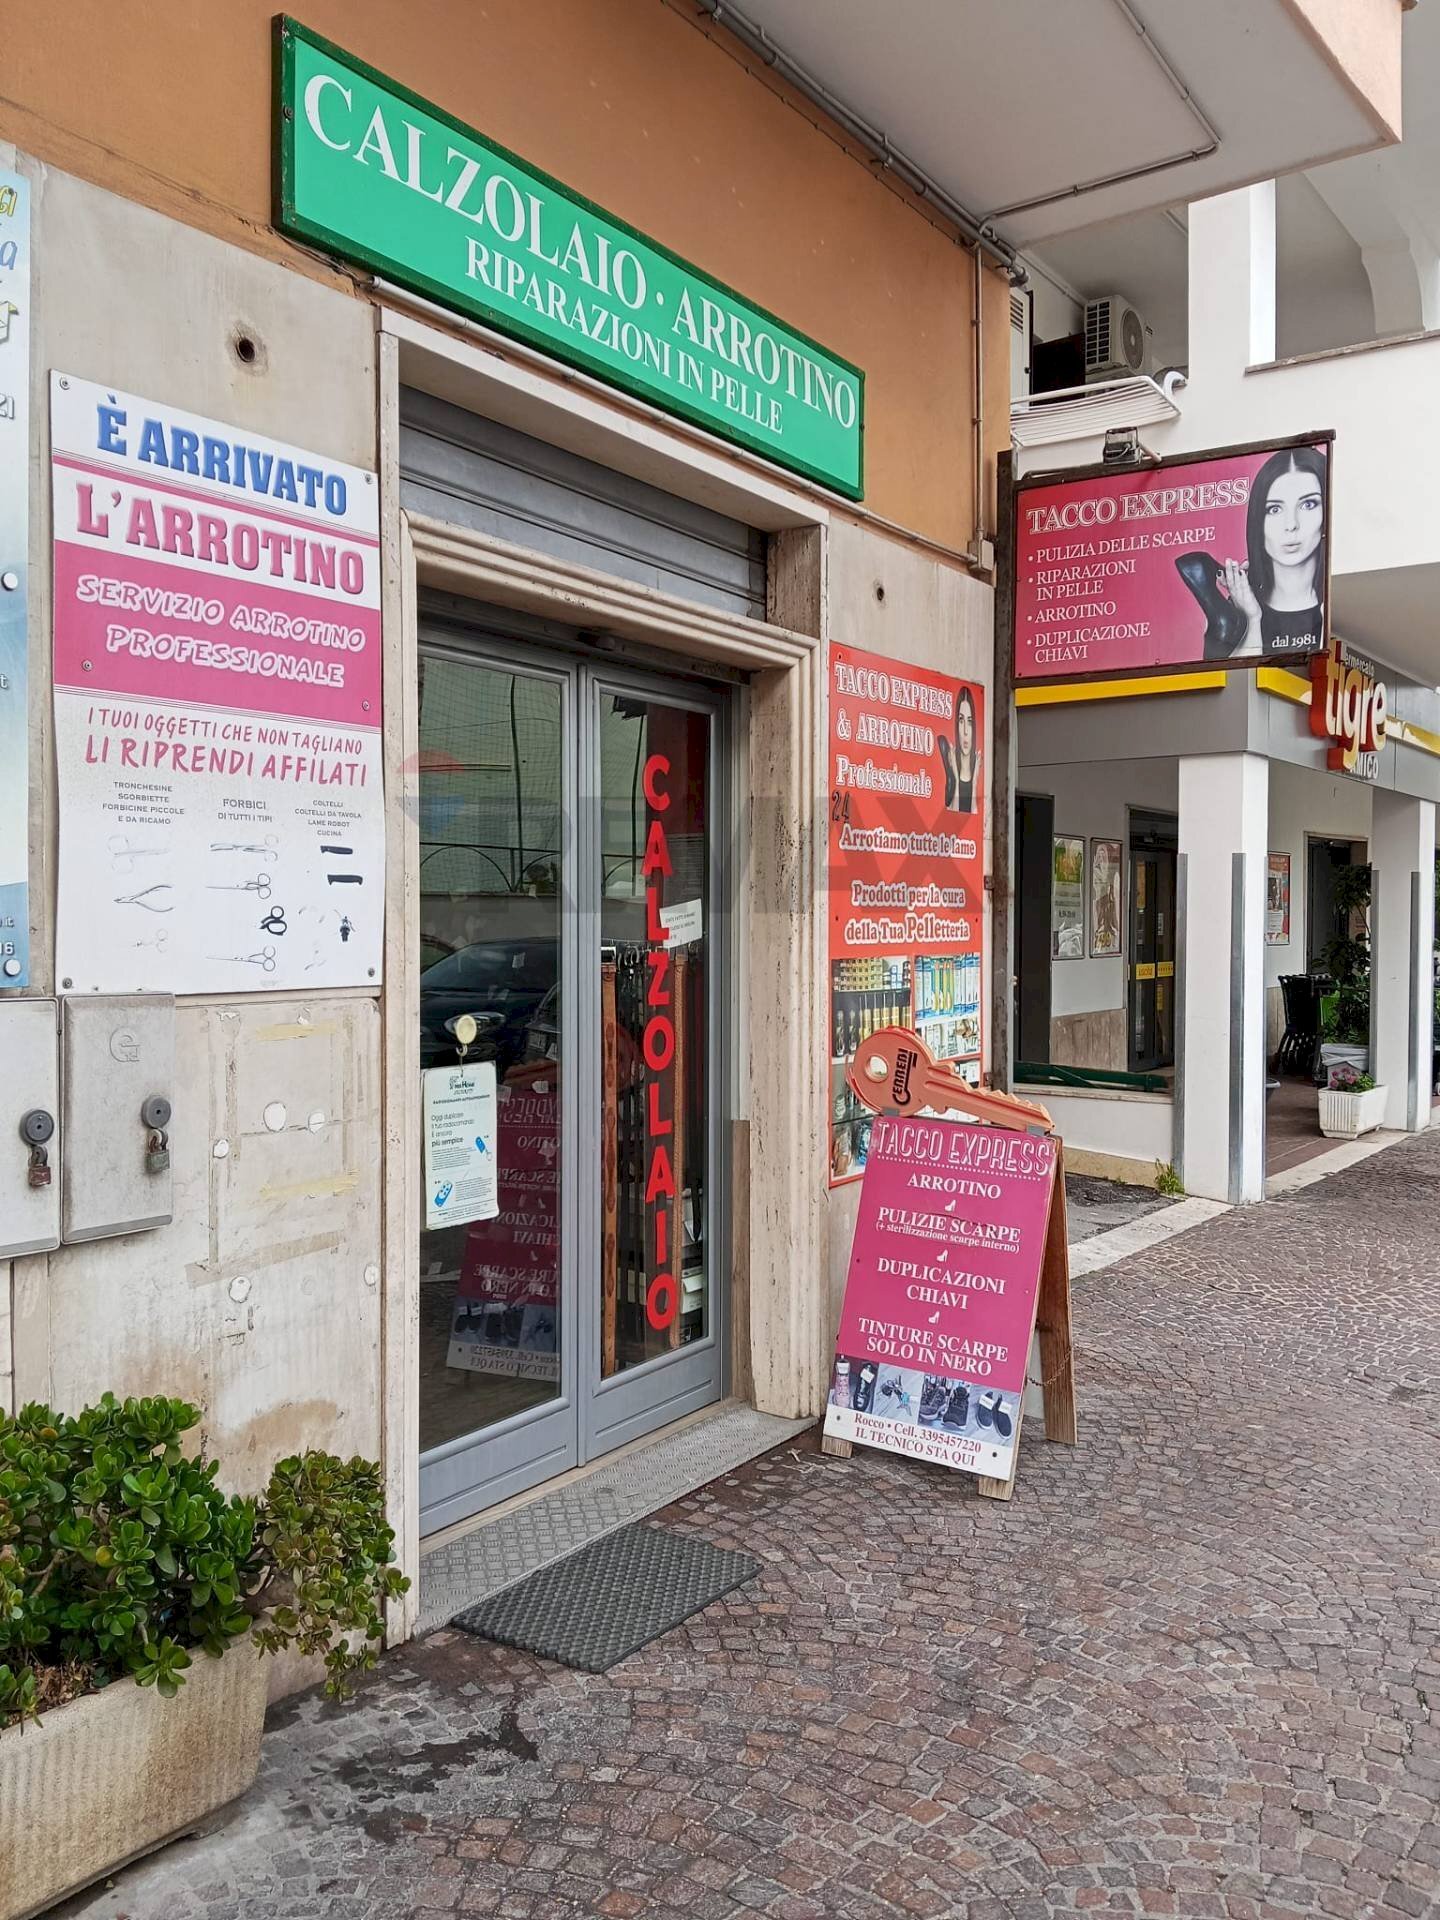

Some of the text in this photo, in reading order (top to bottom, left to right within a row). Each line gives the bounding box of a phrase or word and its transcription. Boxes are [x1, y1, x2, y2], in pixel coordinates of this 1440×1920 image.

[303, 73, 857, 428] CALZOLAIO ARROTINO
[464, 235, 785, 435] RIPARAZIONI IN PELLE
[97, 393, 347, 516] È ARRIVATO
[1026, 477, 1250, 535] TACCO EXPRESS
[75, 481, 364, 596] L'ARROTINO
[1036, 526, 1216, 564] PULIZIA DELLE SCARPE
[1036, 559, 1137, 585] RIPARAZIONI
[1036, 579, 1104, 602] IN PELLE
[75, 574, 365, 653] SERVIZIO ARROTINO
[1035, 601, 1117, 623] ARROTINO
[1035, 622, 1151, 648] DUPLICAZIONE
[1272, 634, 1317, 649] dal 1981
[106, 625, 345, 688] PROFESSIONALE
[1035, 645, 1088, 665] CHIAVI
[834, 660, 954, 720] TACCO EXPRESS
[1326, 640, 1387, 770] tigre
[100, 708, 138, 729] TUOI
[144, 714, 217, 740] OGGETTI
[221, 723, 252, 743] CHE
[257, 727, 287, 747] NON
[291, 731, 362, 755] TAGLIANO
[837, 709, 935, 756] & ARROTINO
[85, 734, 367, 787] LI RIPRENDI AFFILATI
[836, 756, 933, 798] Professionale
[222, 798, 266, 810] FORBICI
[832, 790, 852, 823] 24
[840, 823, 977, 859] Arrotiamo tutte le lame
[852, 879, 965, 911] Prodotti per la cura
[845, 912, 970, 943] della Tua Pelletteria
[641, 754, 677, 1330] CALZOLAIO
[877, 1122, 1050, 1176] TACCO EXPRESS
[907, 1172, 1001, 1200] ARROTINO
[878, 1206, 1021, 1243] PULIZIE SCARPE
[886, 1220, 948, 1241] sterilizzazione
[950, 1235, 979, 1249] scarpe
[981, 1238, 1019, 1254] interno)
[878, 1258, 1006, 1294] DUPLICAZIONI
[906, 1284, 968, 1310] CHIAVI
[858, 1317, 1008, 1362] TINTURE SCARPE
[866, 1337, 992, 1376] SOLO IN NERO
[854, 1413, 885, 1431] Rocco
[894, 1422, 917, 1438] Cell.
[855, 1427, 976, 1467] IL TECNICO STA QUI
